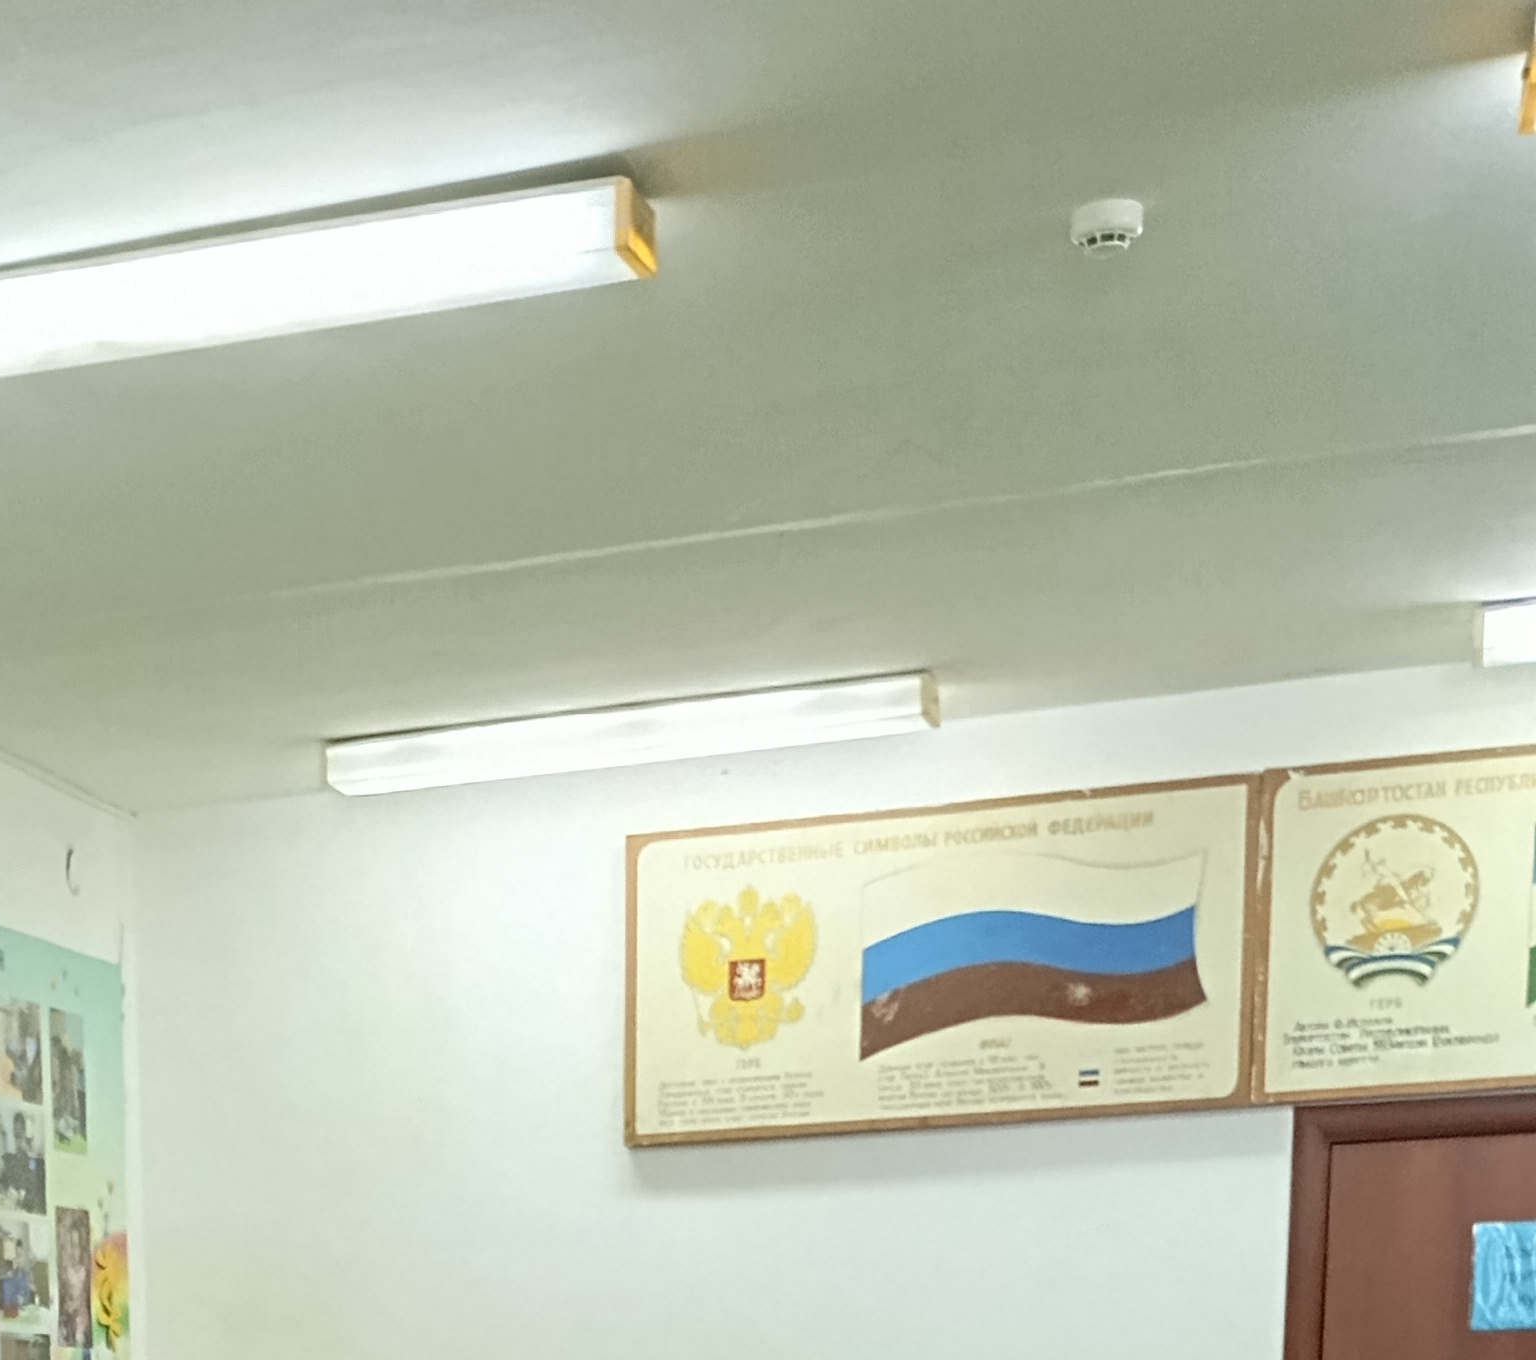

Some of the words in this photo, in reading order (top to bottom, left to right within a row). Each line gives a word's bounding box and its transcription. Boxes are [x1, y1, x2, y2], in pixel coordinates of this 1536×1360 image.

[682, 841, 844, 872] ГОСУДАРСТВЕННЫЕ
[853, 831, 938, 857] СИМВОЛЫ
[943, 820, 1039, 847] РОССИЙСКОЙ
[1046, 810, 1155, 838] ФЕДЕРАЦИИ
